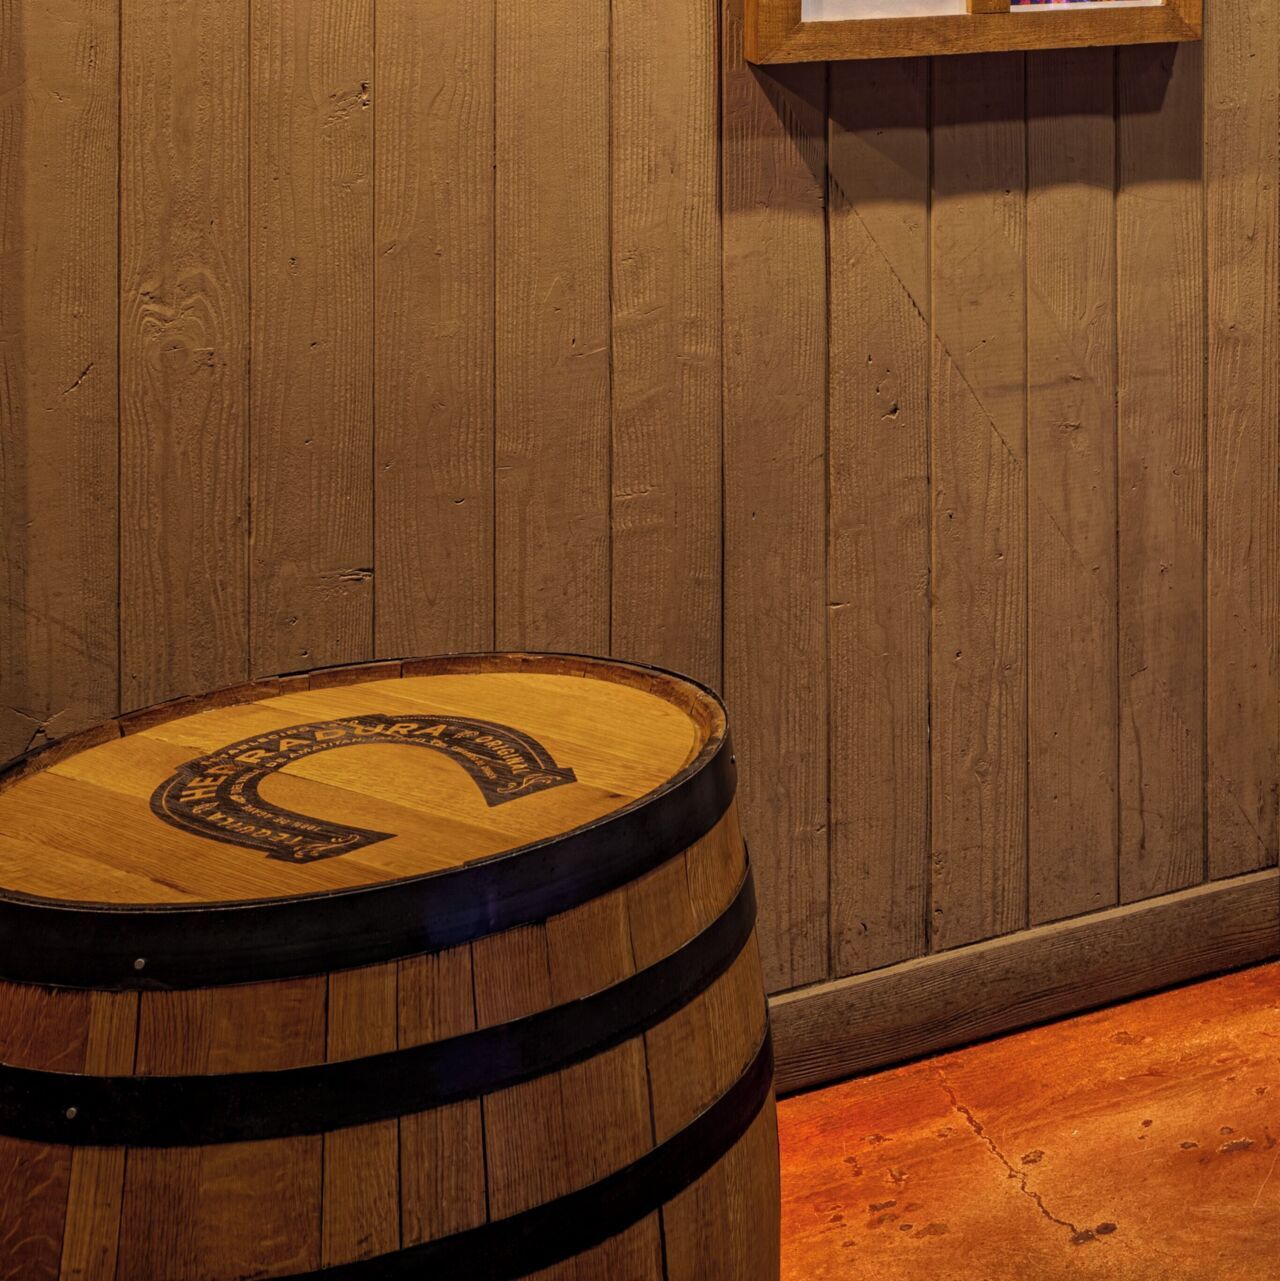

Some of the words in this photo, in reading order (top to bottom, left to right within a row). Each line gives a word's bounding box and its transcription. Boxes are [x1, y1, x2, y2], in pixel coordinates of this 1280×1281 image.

[179, 722, 448, 802] HERRADURA
[477, 734, 531, 775] ORIGINAL
[205, 810, 304, 846] TEQUILA
